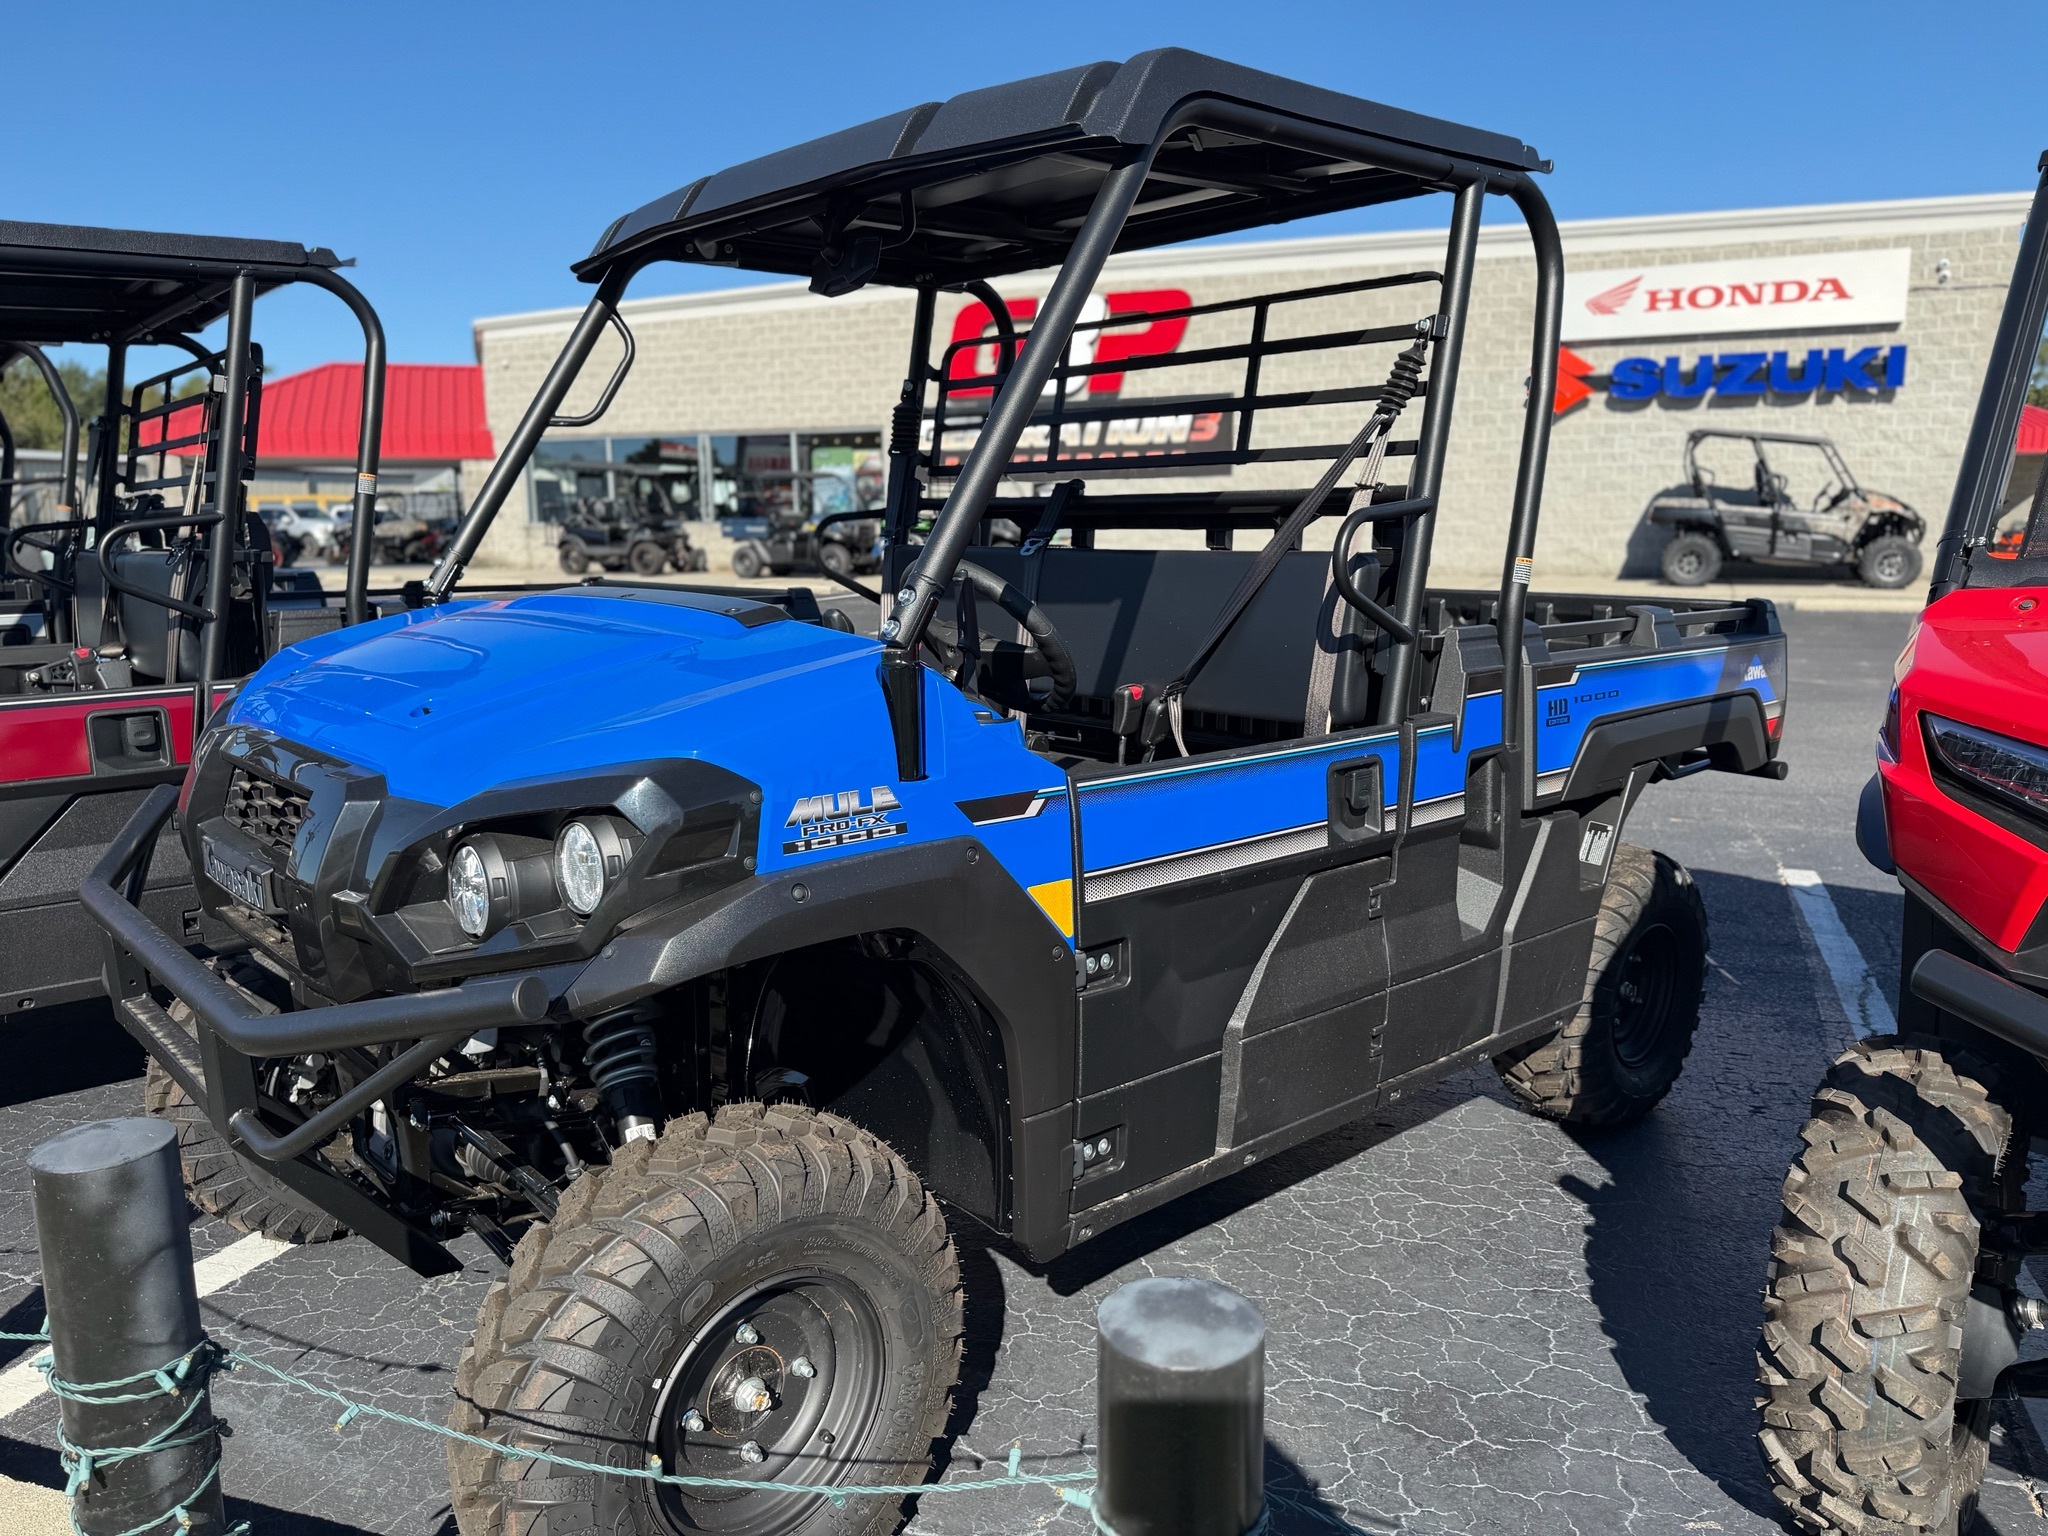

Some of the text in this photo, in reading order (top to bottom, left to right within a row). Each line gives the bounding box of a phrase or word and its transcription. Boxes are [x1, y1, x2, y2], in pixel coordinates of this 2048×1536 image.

[1643, 276, 1853, 313] HONDA
[1608, 344, 1907, 400] SUZUKI
[1548, 698, 1568, 717] HD
[1574, 690, 1619, 704] 1000
[785, 786, 902, 828] MULE
[794, 824, 898, 852] 1000
[801, 812, 888, 838] PRO-FX
[202, 839, 264, 911] Kawasaki
